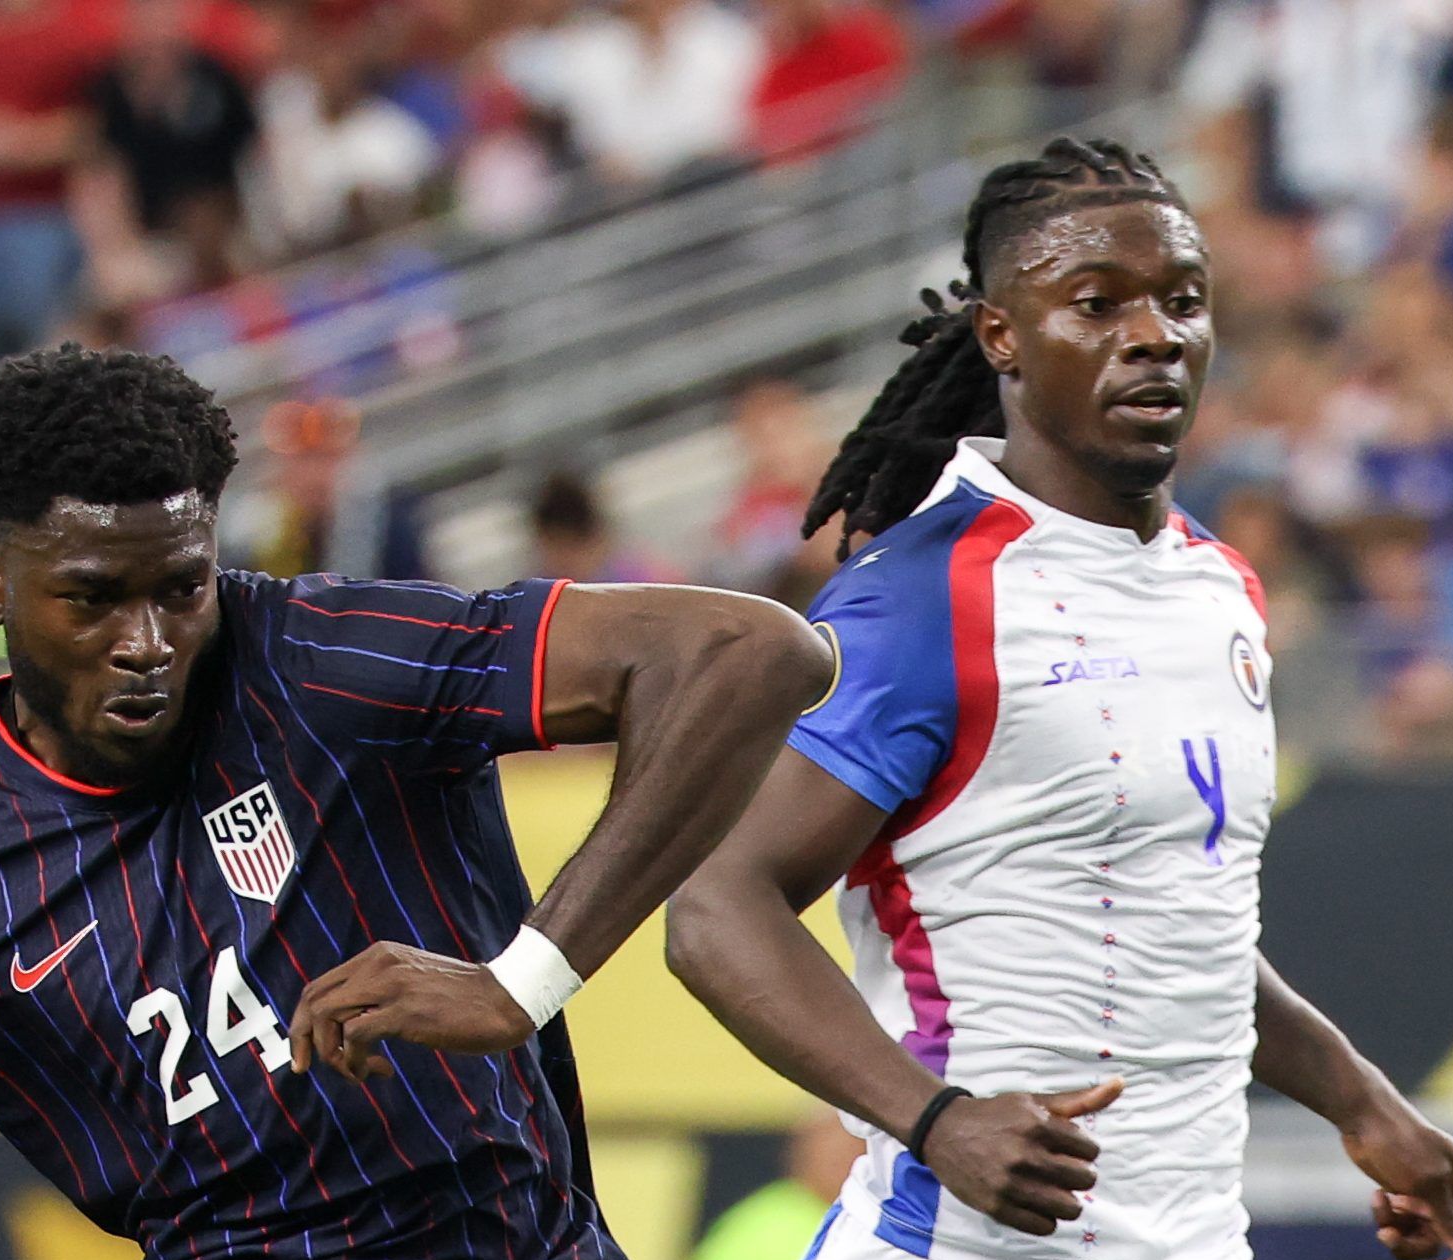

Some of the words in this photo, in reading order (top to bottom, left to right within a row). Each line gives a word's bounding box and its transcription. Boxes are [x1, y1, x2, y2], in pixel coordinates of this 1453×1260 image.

[1042, 656, 1140, 686] SAETA
[208, 790, 273, 844] USA
[126, 945, 293, 1127] 24
